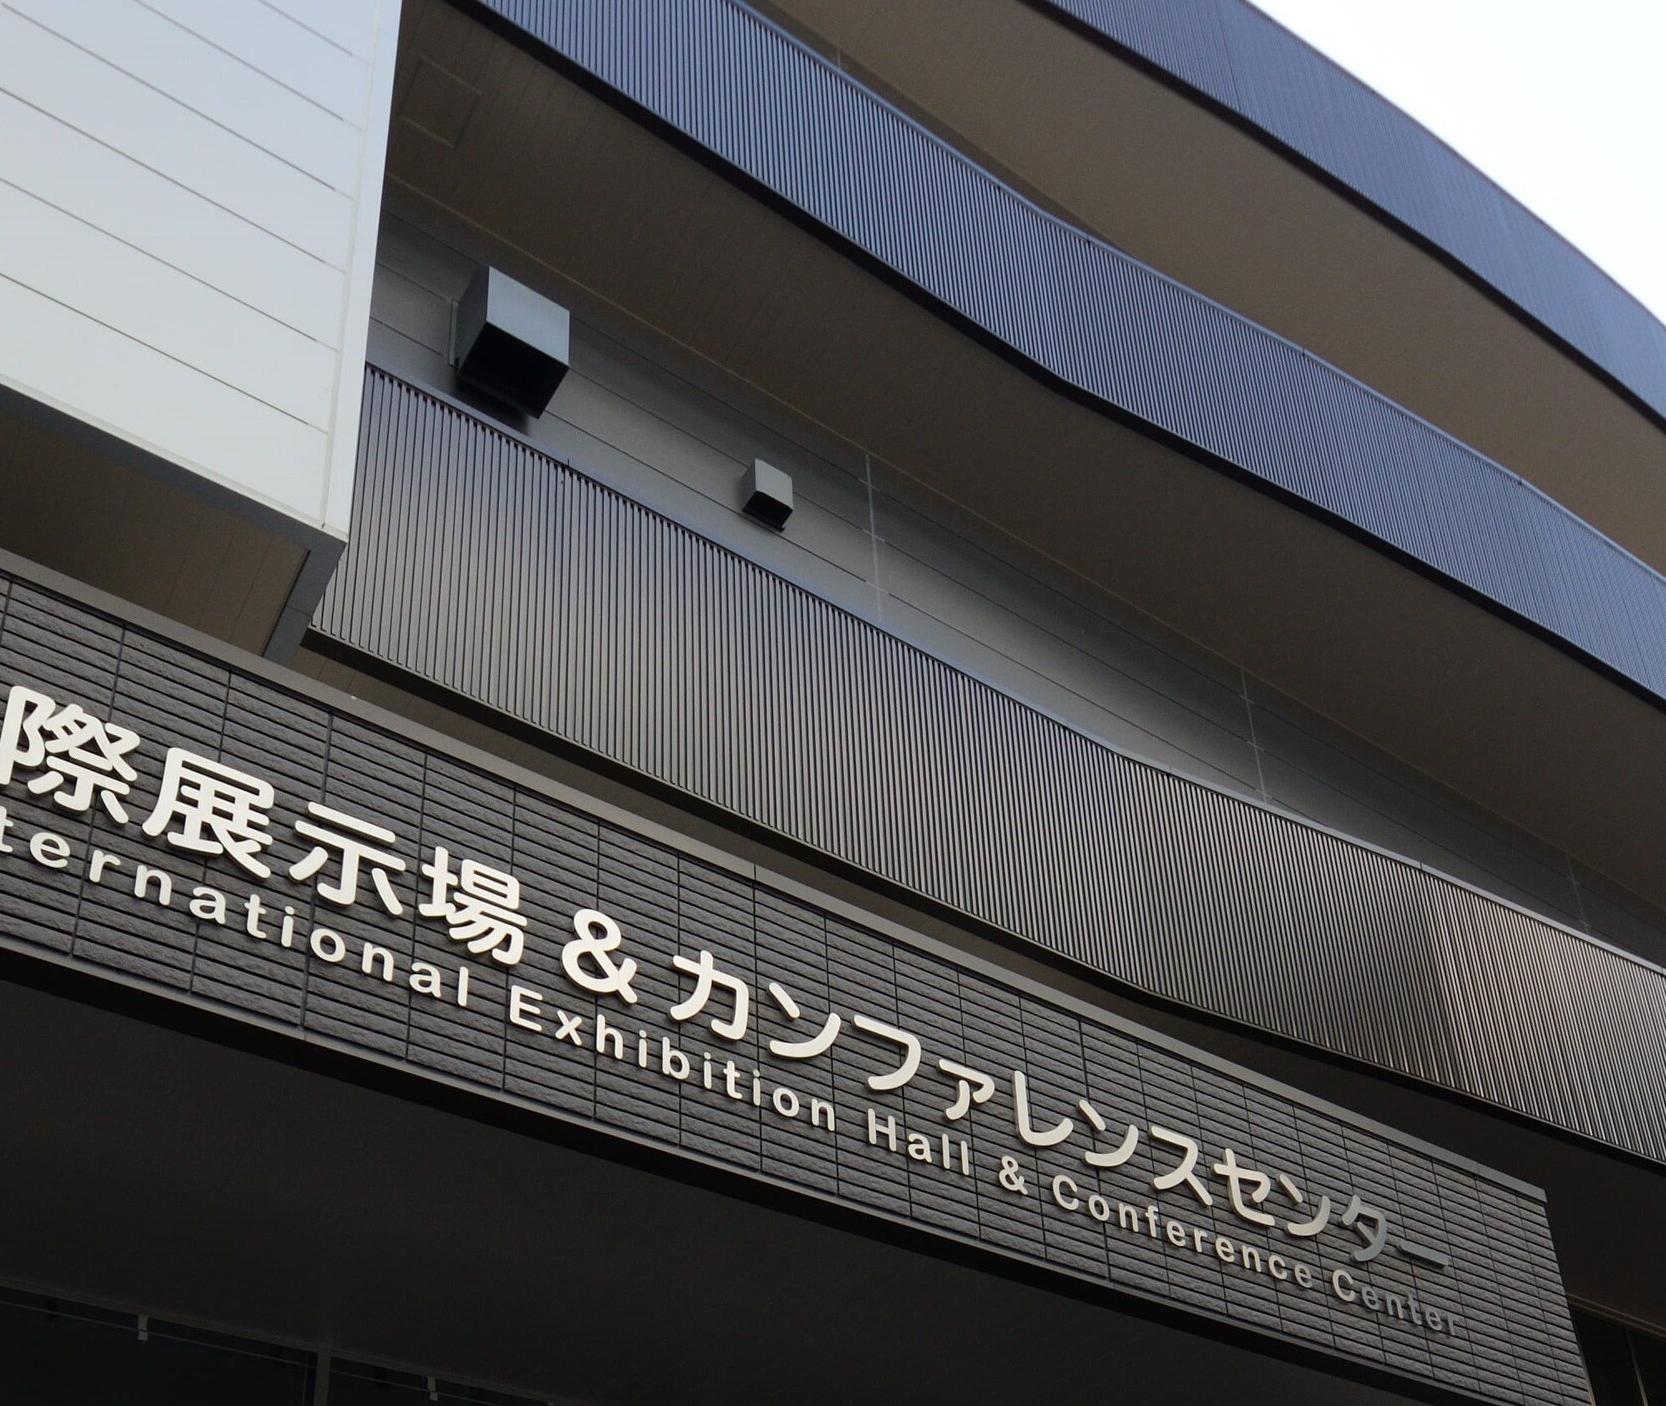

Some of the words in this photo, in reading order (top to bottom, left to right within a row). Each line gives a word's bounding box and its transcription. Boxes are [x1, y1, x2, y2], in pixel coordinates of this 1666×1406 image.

[509, 984, 837, 1134] Exhibition
[866, 1107, 973, 1178] Hall
[998, 1154, 1030, 1196] &
[1050, 1171, 1313, 1289] Conference
[1332, 1268, 1463, 1336] Center
[669, 948, 1451, 1269] カンファレンスセンター
